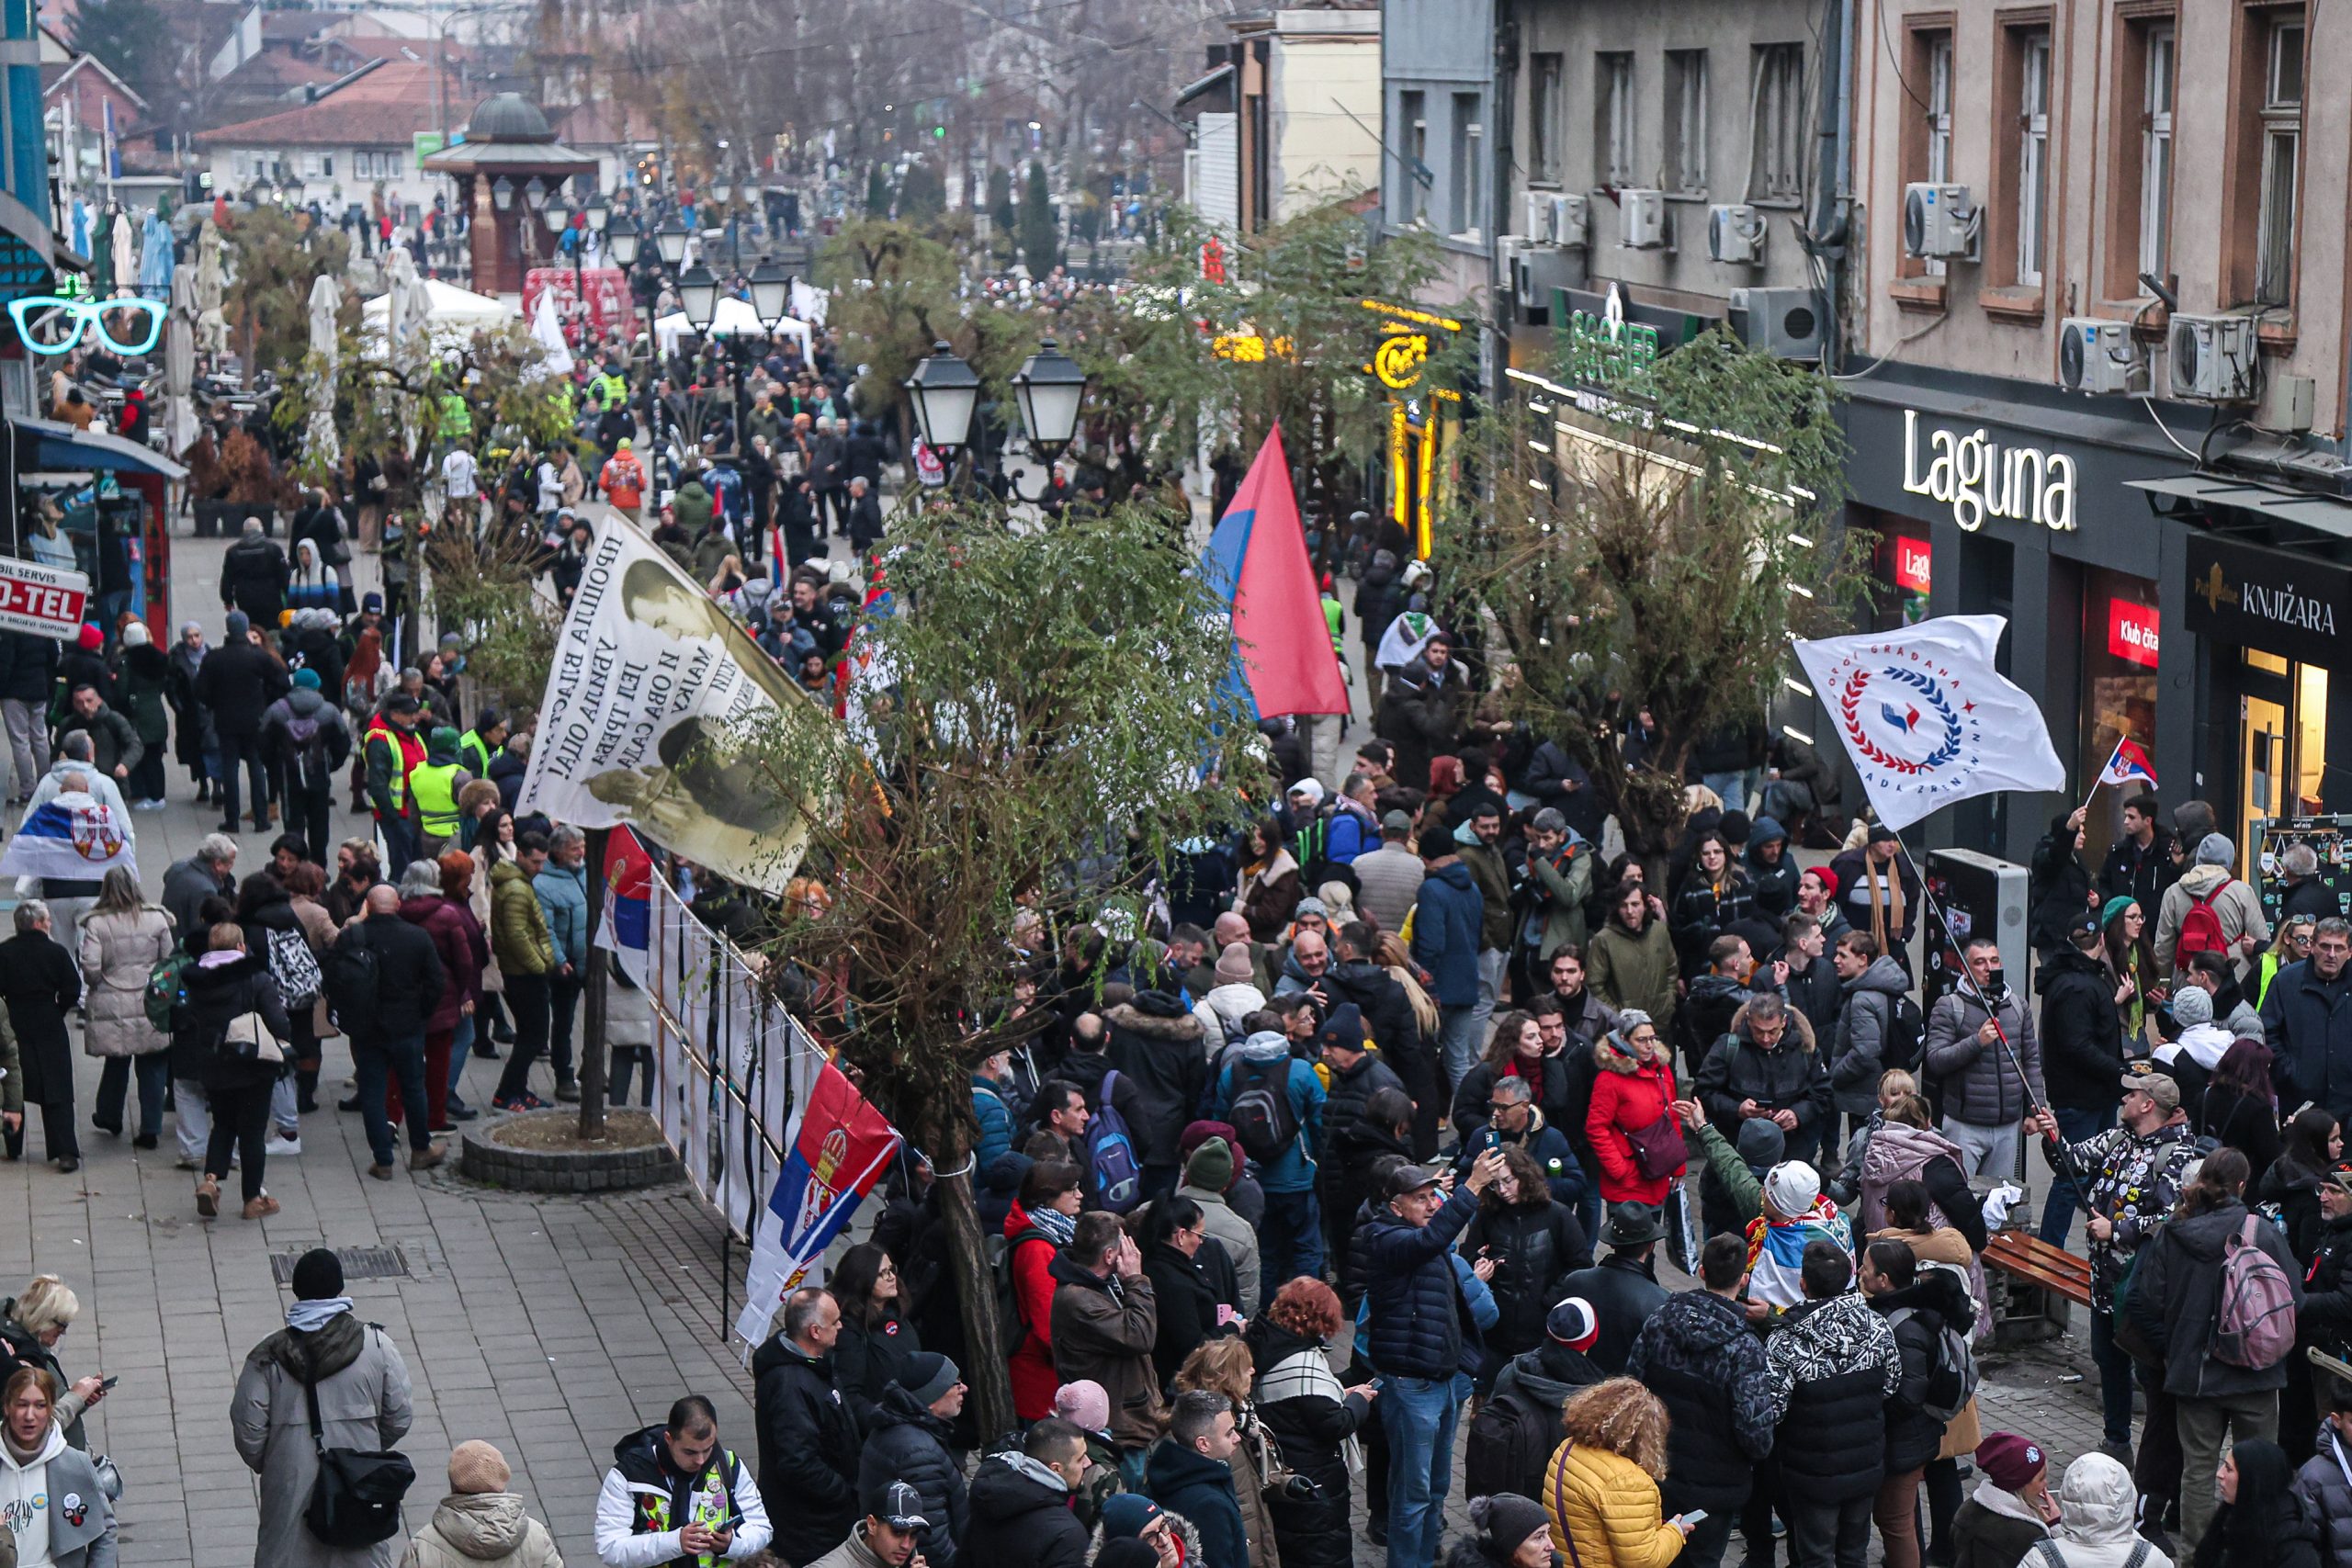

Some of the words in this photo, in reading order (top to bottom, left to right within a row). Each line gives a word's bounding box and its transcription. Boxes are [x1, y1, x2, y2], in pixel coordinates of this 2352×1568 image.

[1904, 410, 2078, 532] Laguna
[18, 567, 57, 583] SERVIS
[2243, 581, 2336, 637] KNJIŽARA
[2120, 619, 2141, 642] Klub
